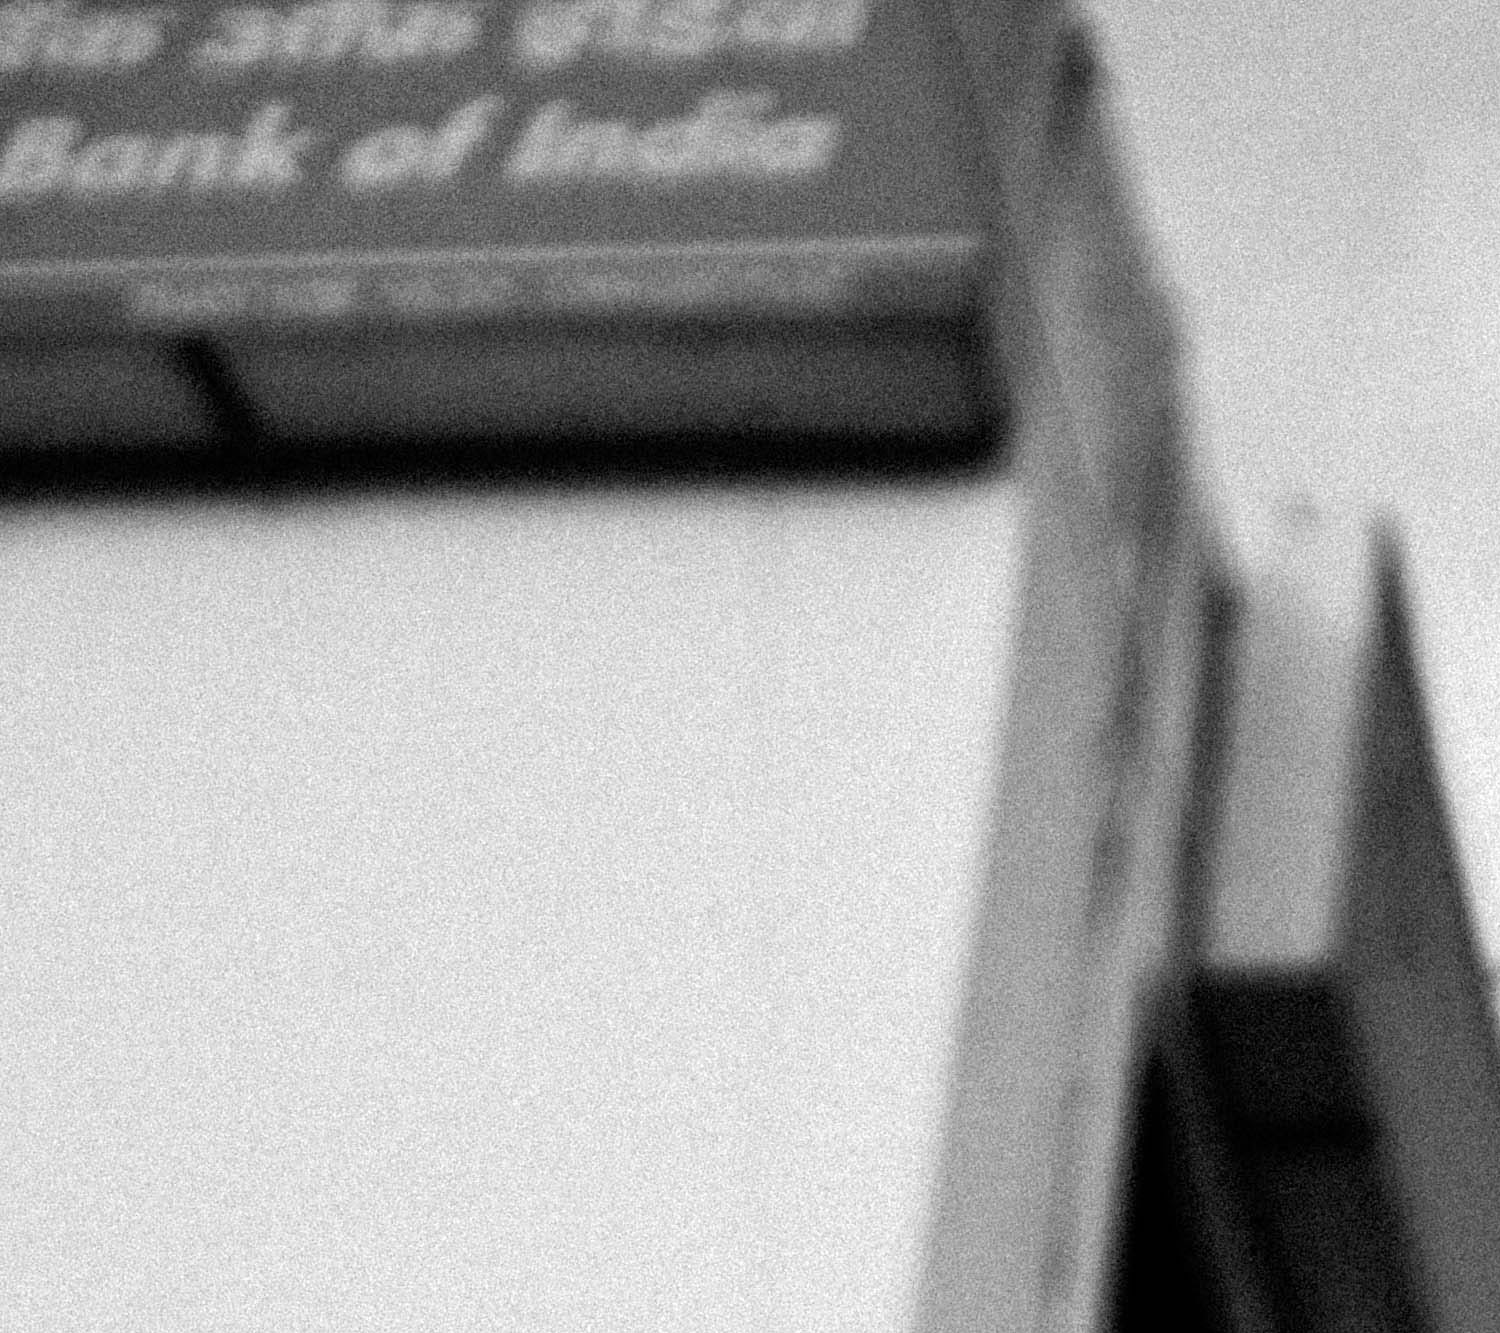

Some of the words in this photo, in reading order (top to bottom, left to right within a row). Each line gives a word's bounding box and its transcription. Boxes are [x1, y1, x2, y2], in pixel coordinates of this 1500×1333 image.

[0, 102, 310, 194] Bank
[338, 93, 504, 188] of
[503, 90, 842, 182] India
